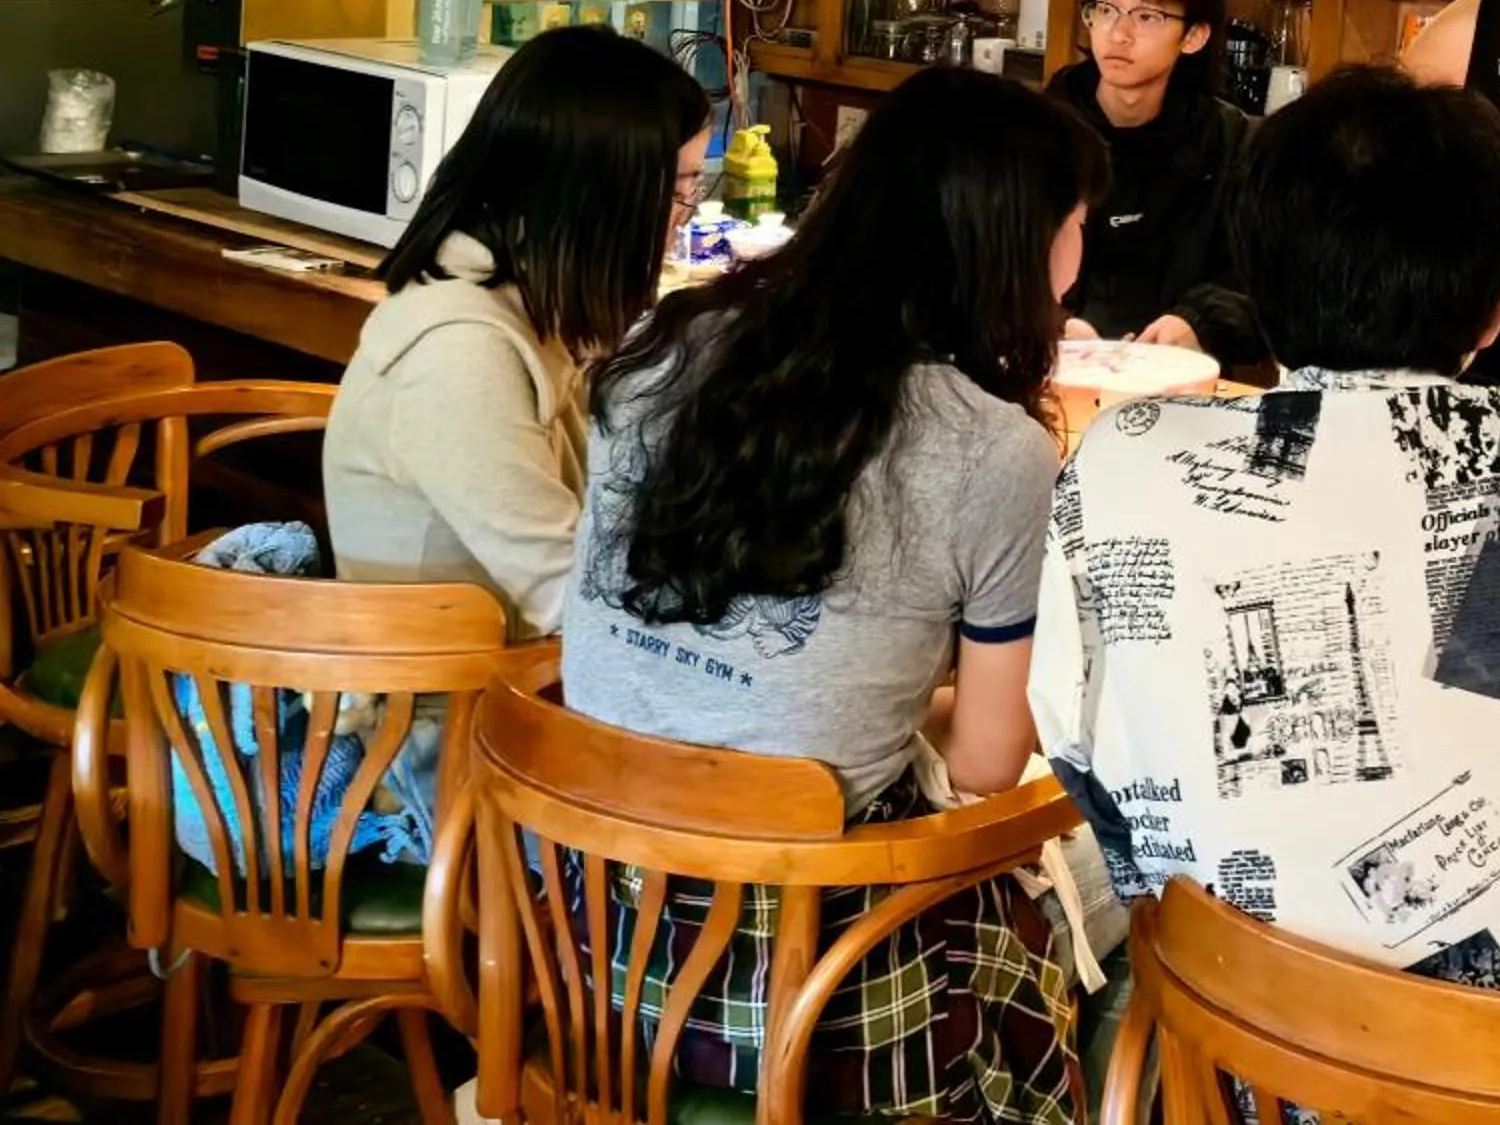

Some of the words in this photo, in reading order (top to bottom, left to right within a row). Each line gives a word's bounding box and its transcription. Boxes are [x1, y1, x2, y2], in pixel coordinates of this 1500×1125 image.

[1421, 502, 1491, 533] Officials
[1423, 529, 1481, 553] slayer
[625, 627, 671, 659] STARRY
[674, 646, 701, 668] SKY
[705, 658, 734, 682] GYM
